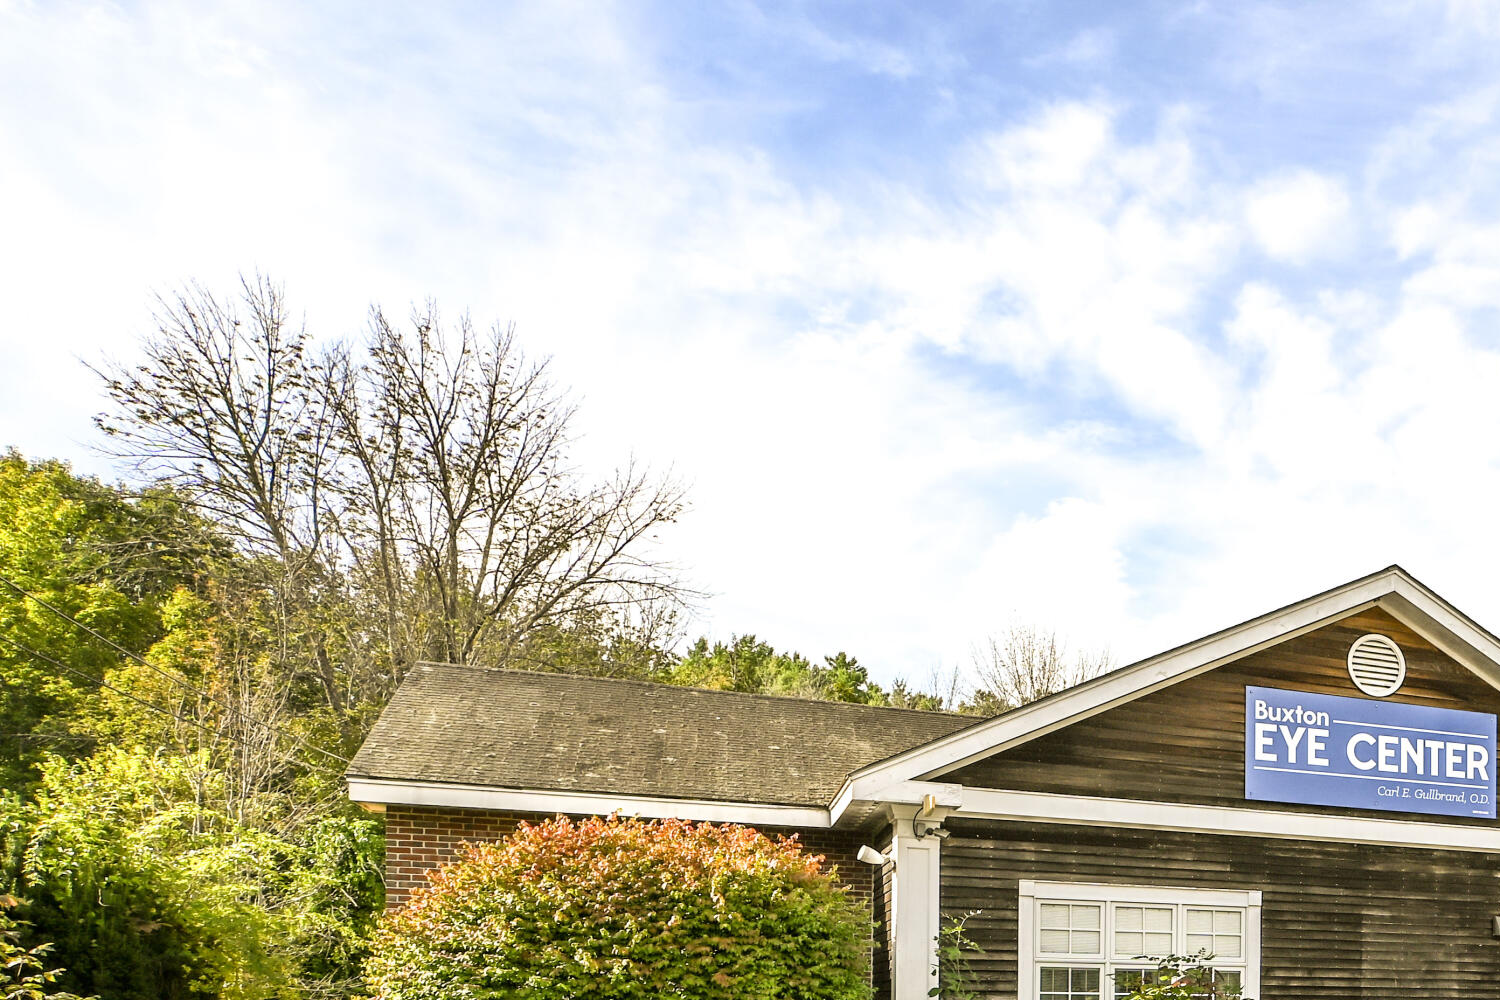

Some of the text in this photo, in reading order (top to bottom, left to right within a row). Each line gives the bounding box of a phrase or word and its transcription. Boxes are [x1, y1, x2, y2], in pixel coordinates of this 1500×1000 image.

[1255, 700, 1330, 727] Buxton
[1254, 722, 1490, 781] EYE CENTER
[1377, 785, 1490, 805] Carl E. Gullbrand, O.D.
